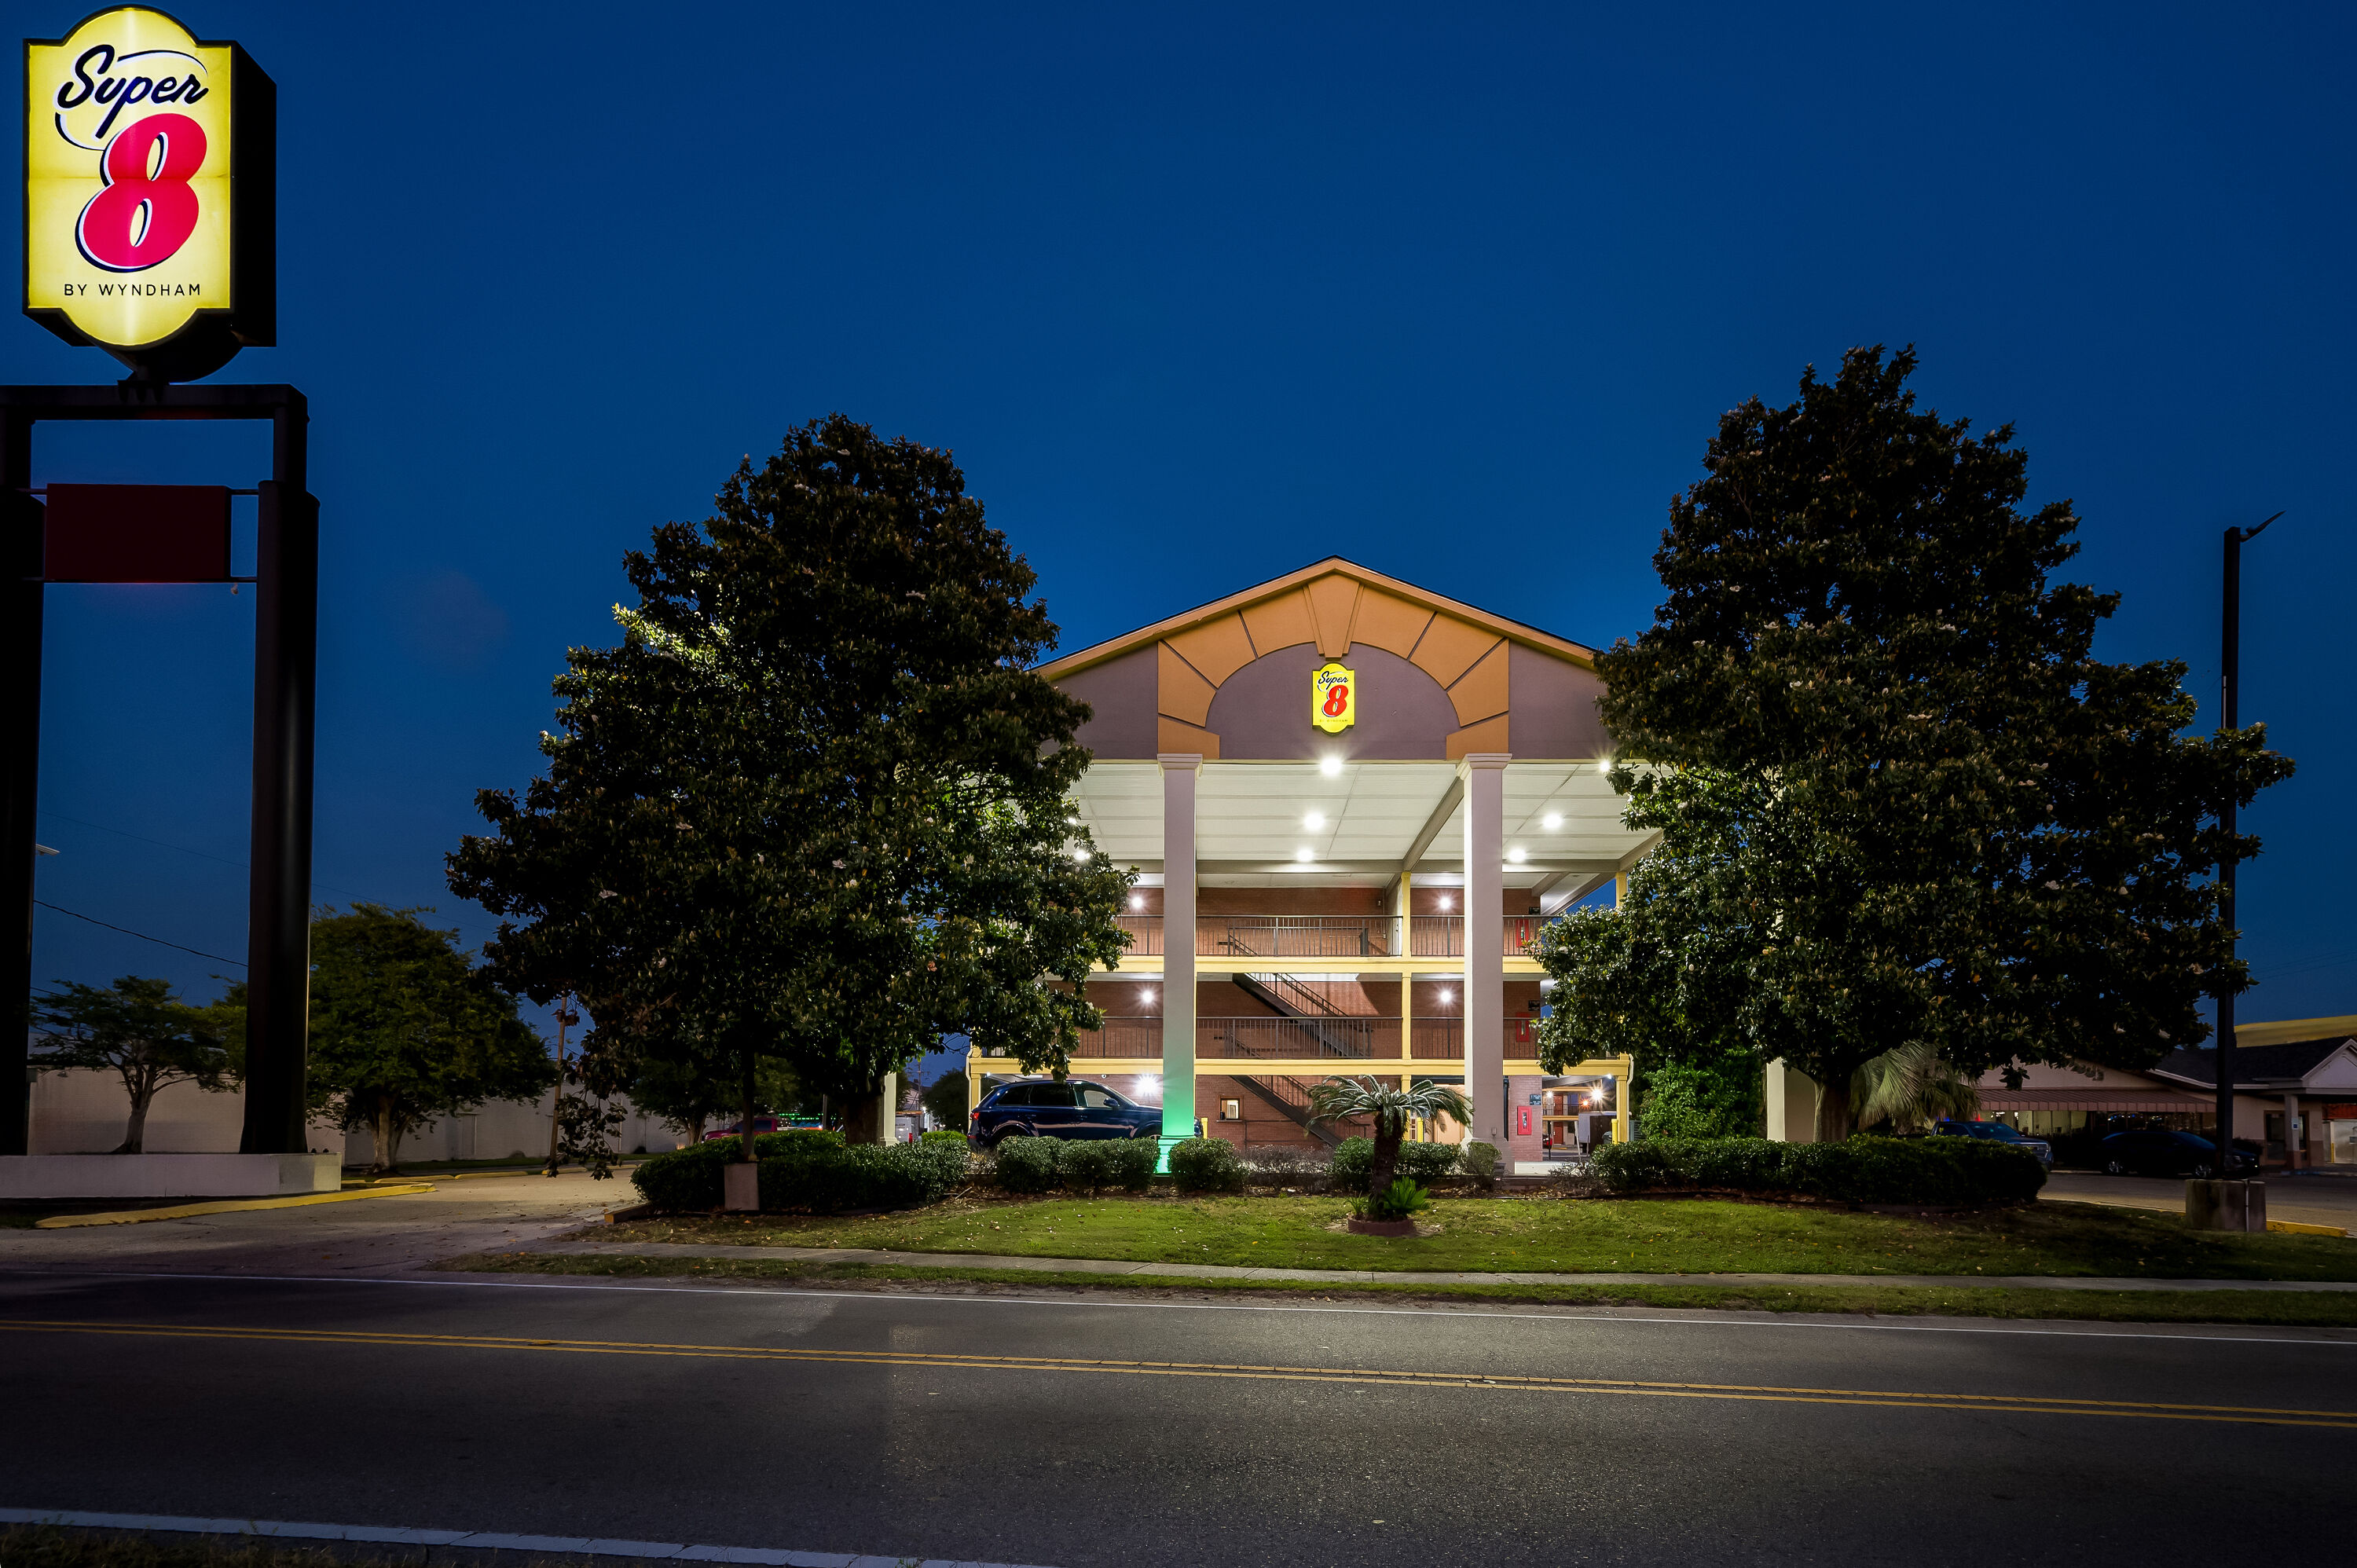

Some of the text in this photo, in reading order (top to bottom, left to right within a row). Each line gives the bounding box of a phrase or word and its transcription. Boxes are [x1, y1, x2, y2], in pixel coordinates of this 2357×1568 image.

[57, 44, 209, 139] Super
[75, 113, 207, 273] 8
[64, 283, 201, 296] BY WYNDHAM
[1318, 671, 1348, 691] Super
[1321, 685, 1349, 717] 8
